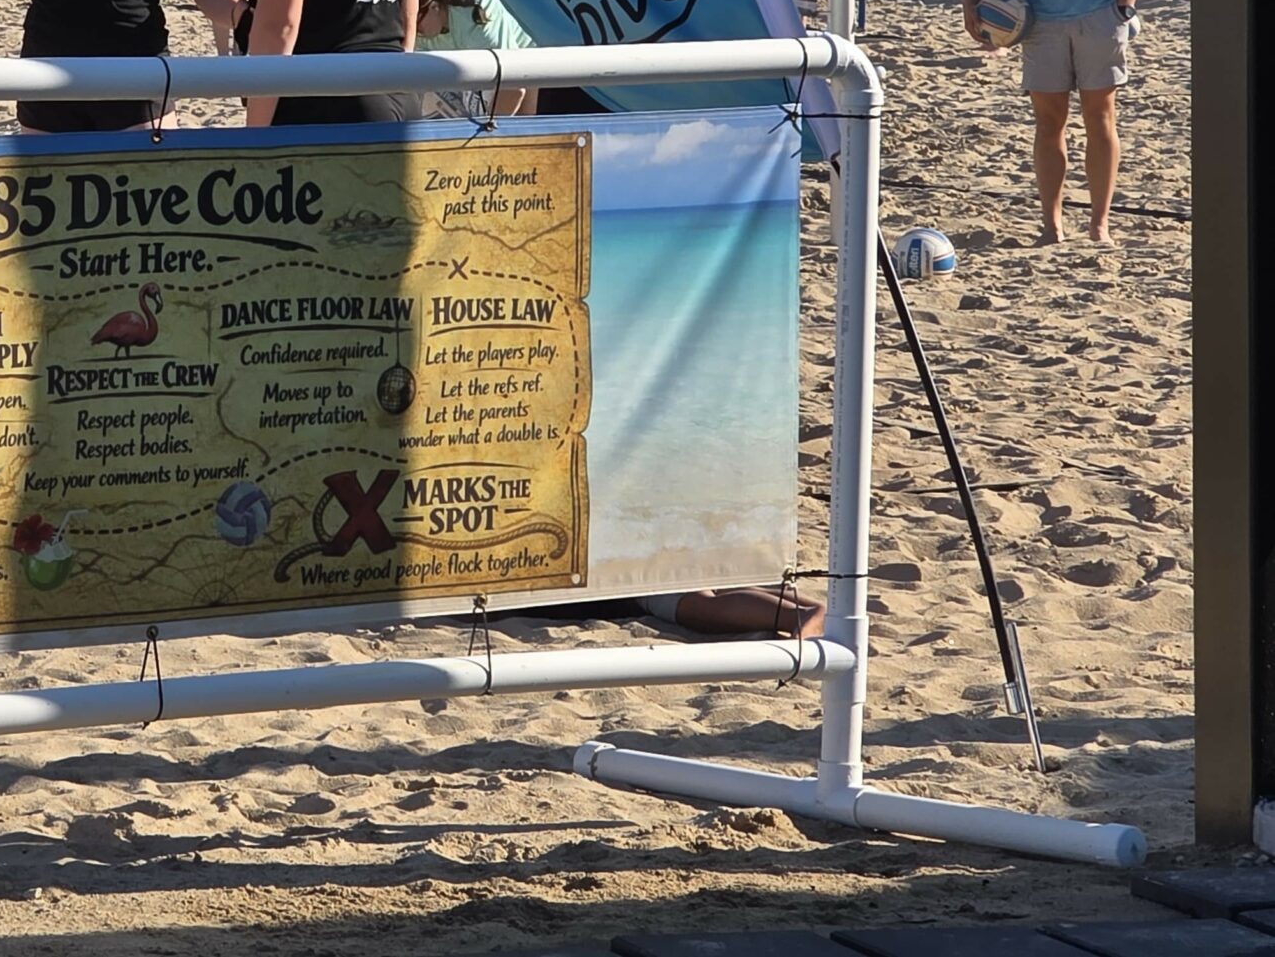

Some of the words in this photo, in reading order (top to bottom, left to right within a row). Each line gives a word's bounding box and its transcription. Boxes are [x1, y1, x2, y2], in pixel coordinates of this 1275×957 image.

[425, 170, 462, 191] Zero
[463, 165, 538, 194] judgment
[66, 173, 190, 232] Dive
[198, 165, 324, 226] Code
[442, 196, 476, 224] past
[481, 195, 509, 213] this
[513, 194, 556, 219] point.
[59, 247, 130, 279] Start
[138, 243, 213, 274] Here.
[220, 299, 292, 329] DANCE
[296, 297, 363, 323] FLOOR
[368, 298, 414, 322] LAW
[432, 296, 506, 325] HOUSE
[511, 298, 557, 324] LAW
[240, 343, 322, 366] Confidence
[326, 336, 389, 363] required.
[426, 346, 448, 365] Let
[453, 344, 474, 363] the
[478, 341, 524, 368] players
[528, 339, 559, 365] play.
[46, 364, 133, 397] RESPECT
[133, 371, 159, 386] THE
[162, 362, 220, 386] CREW
[263, 382, 309, 403] Moves
[314, 384, 331, 403] up
[337, 381, 353, 398] to
[441, 380, 463, 398] Let
[468, 377, 489, 395] the
[494, 374, 518, 394] refs
[523, 373, 544, 393] ref.
[77, 409, 135, 437] Respect
[140, 404, 194, 435] people.
[259, 406, 367, 433] interpretation.
[426, 405, 448, 423] Let
[453, 403, 474, 421] the
[479, 404, 529, 425] parents
[75, 439, 134, 465] Respect
[140, 434, 193, 456] bodies.
[399, 430, 444, 449] wonder
[447, 427, 481, 446] what
[484, 431, 492, 443] a
[497, 425, 543, 443] double
[547, 424, 560, 440] is.
[25, 472, 58, 497] Keep
[61, 477, 95, 496] your
[99, 467, 170, 487] comments
[175, 465, 190, 481] to
[192, 458, 250, 488] yourself.
[403, 475, 496, 509] MARKS
[500, 478, 531, 499] THE
[429, 505, 498, 535] SPOT
[301, 563, 349, 587] Where
[353, 560, 391, 584] good
[395, 556, 443, 582] people
[447, 552, 483, 575] flock
[487, 548, 549, 575] together.
